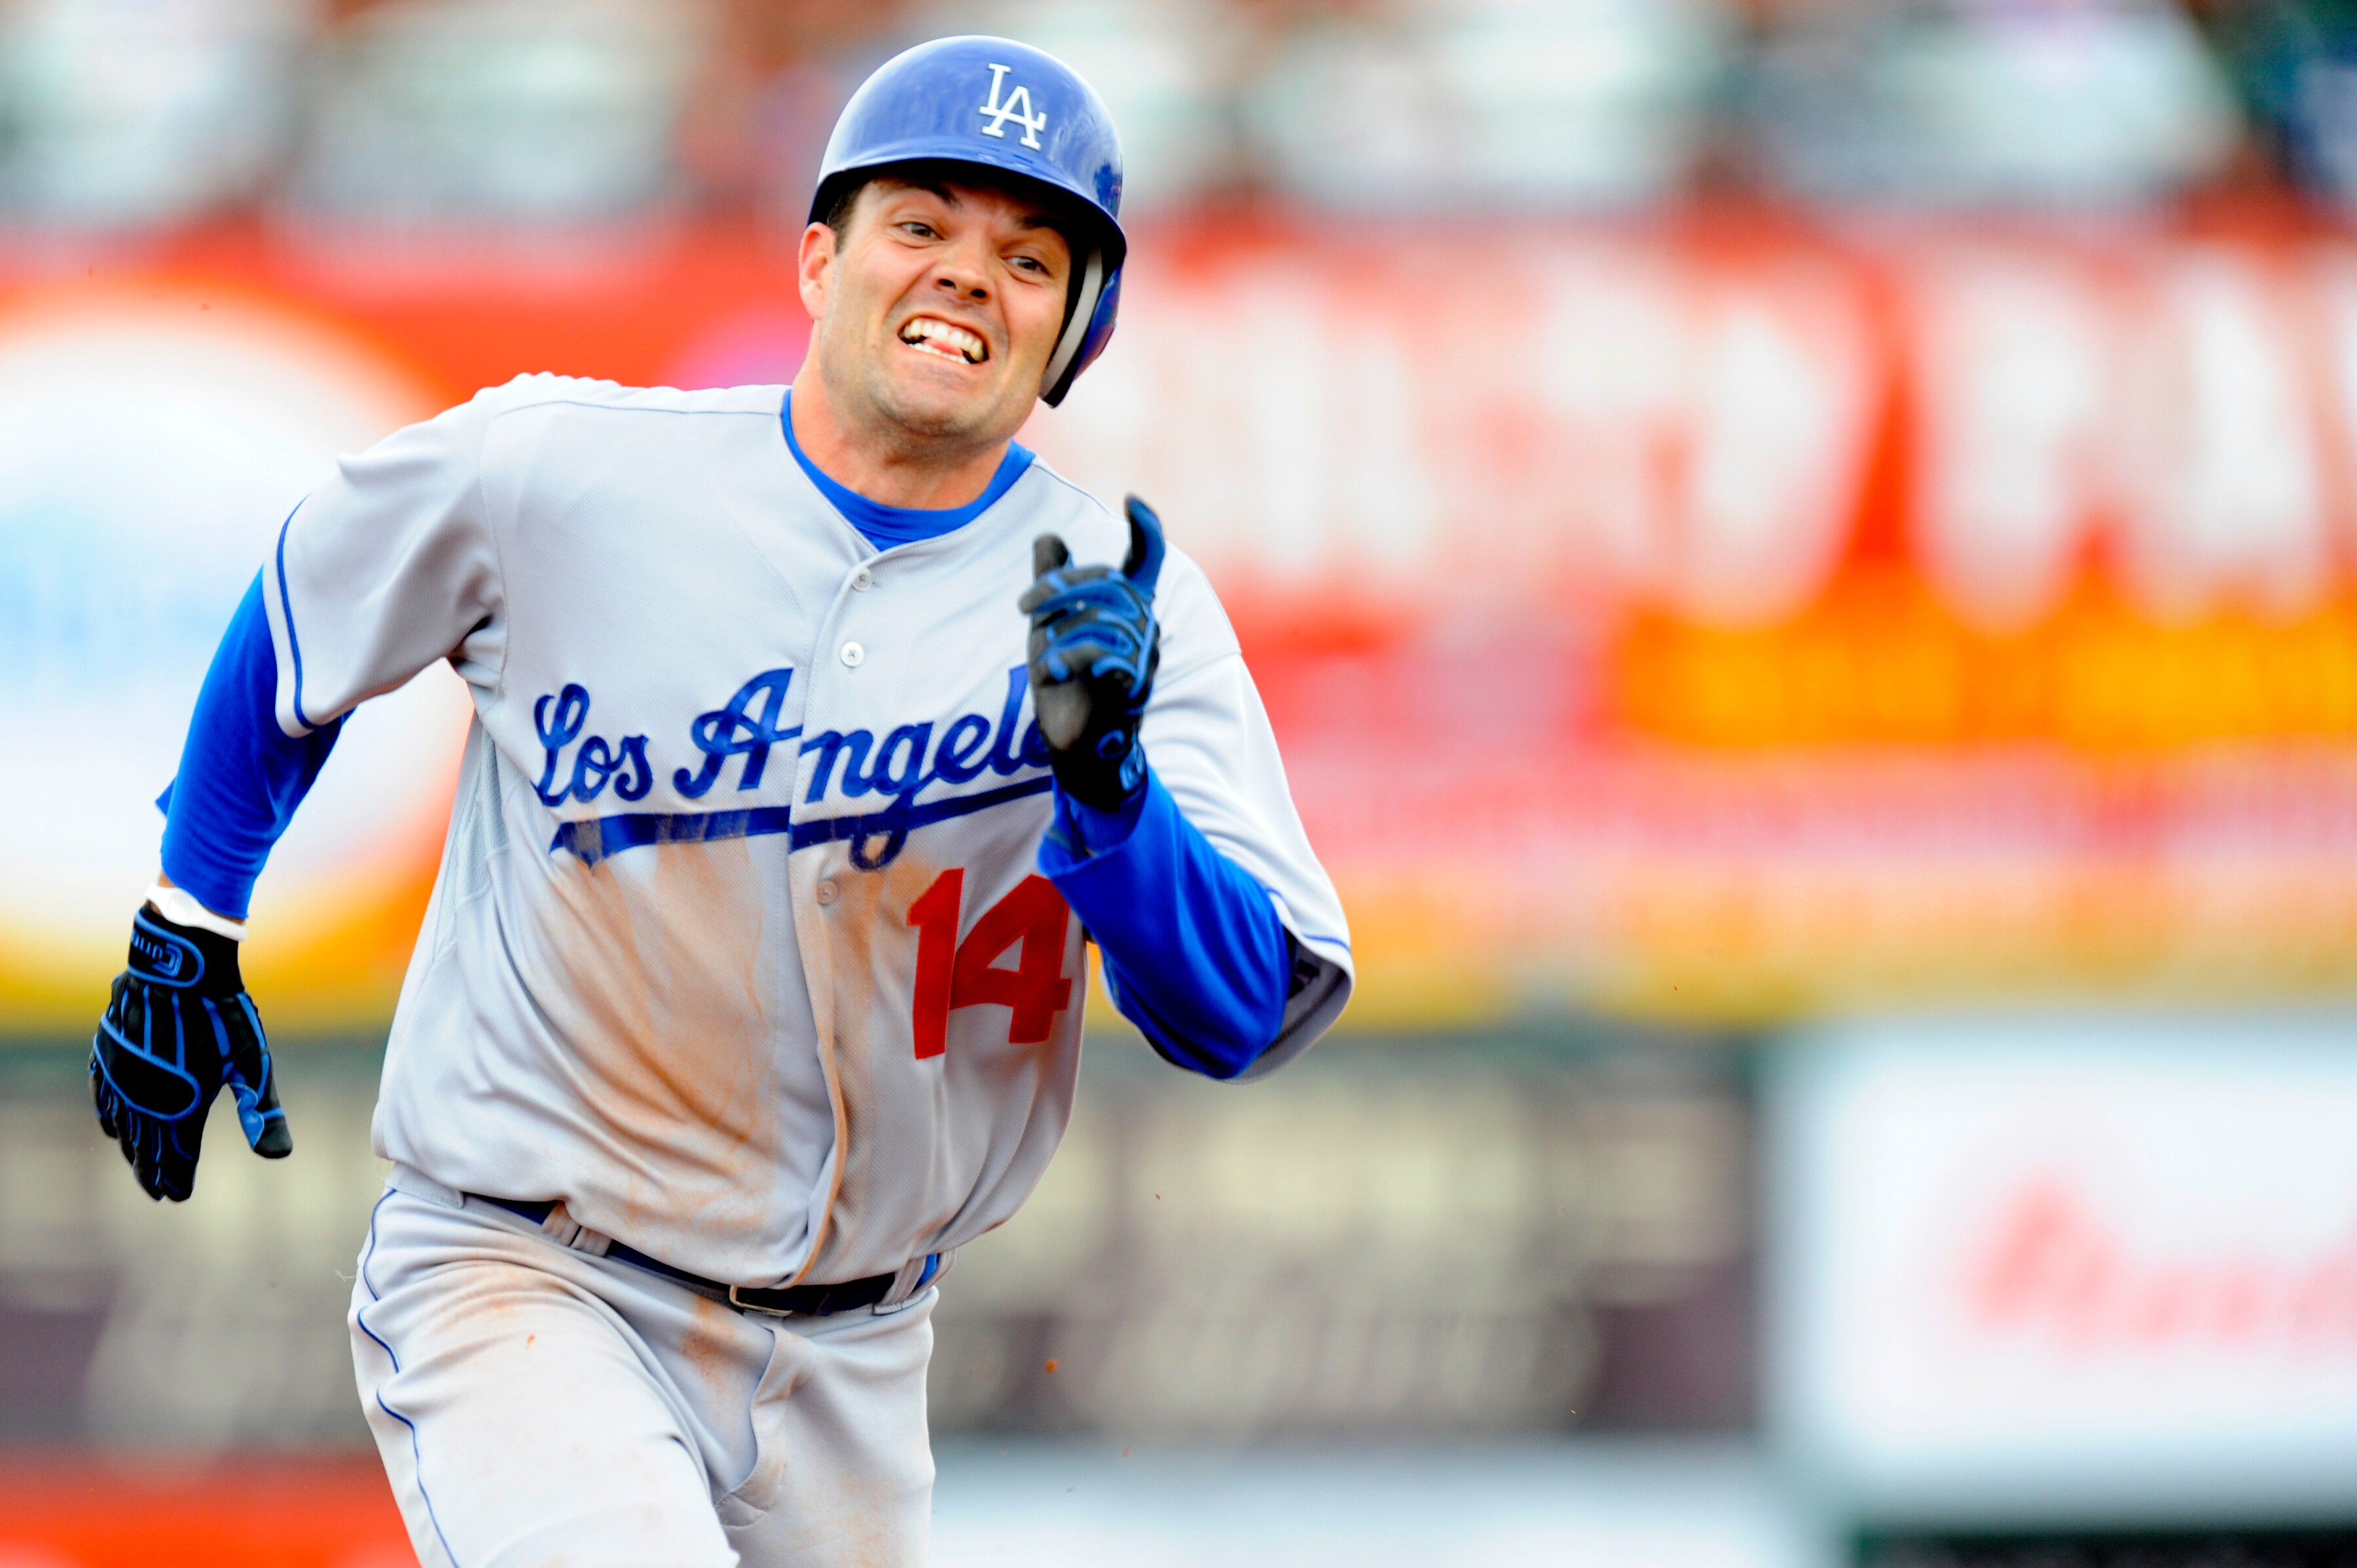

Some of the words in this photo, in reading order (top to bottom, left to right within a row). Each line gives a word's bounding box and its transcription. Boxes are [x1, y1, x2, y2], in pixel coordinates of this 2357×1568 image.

[979, 63, 1046, 151] LA
[530, 683, 653, 807] Los
[906, 867, 1072, 1059] 14
